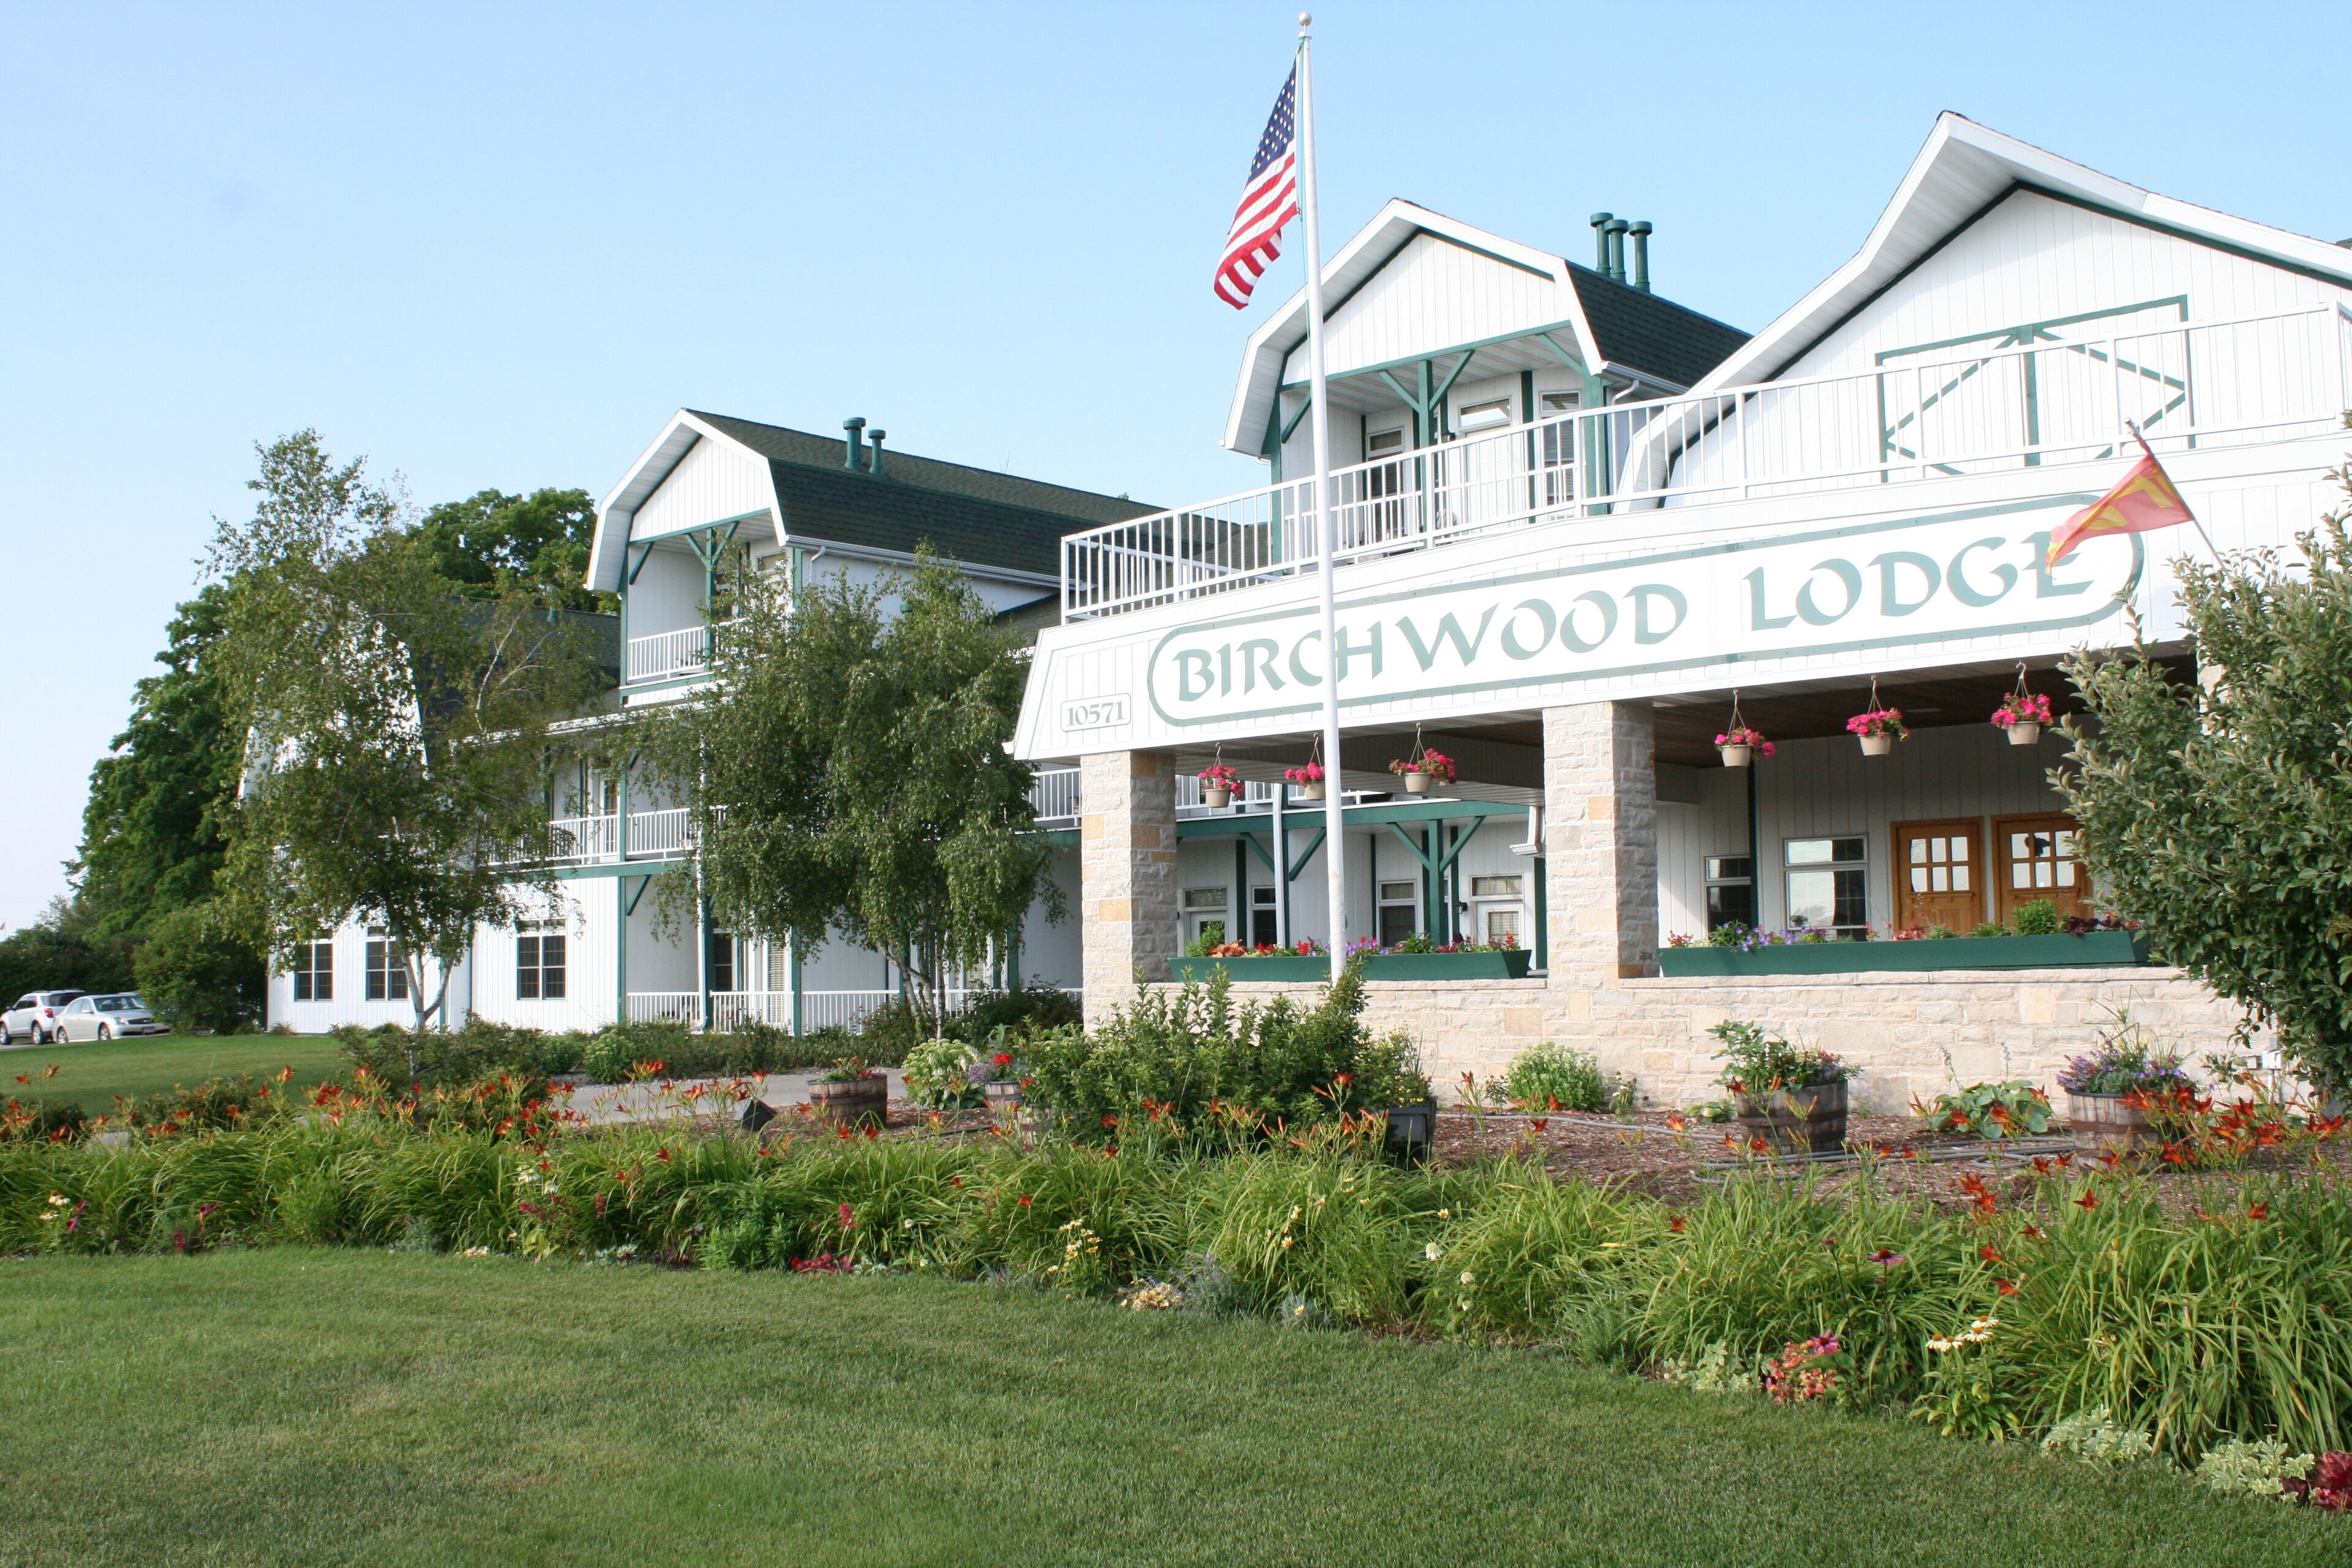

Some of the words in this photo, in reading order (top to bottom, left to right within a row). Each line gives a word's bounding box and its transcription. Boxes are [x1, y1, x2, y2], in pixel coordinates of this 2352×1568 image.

[1171, 584, 1687, 701] BIRCHWOOD
[1742, 531, 2095, 631] LODGE
[1066, 701, 1125, 726] 10571
